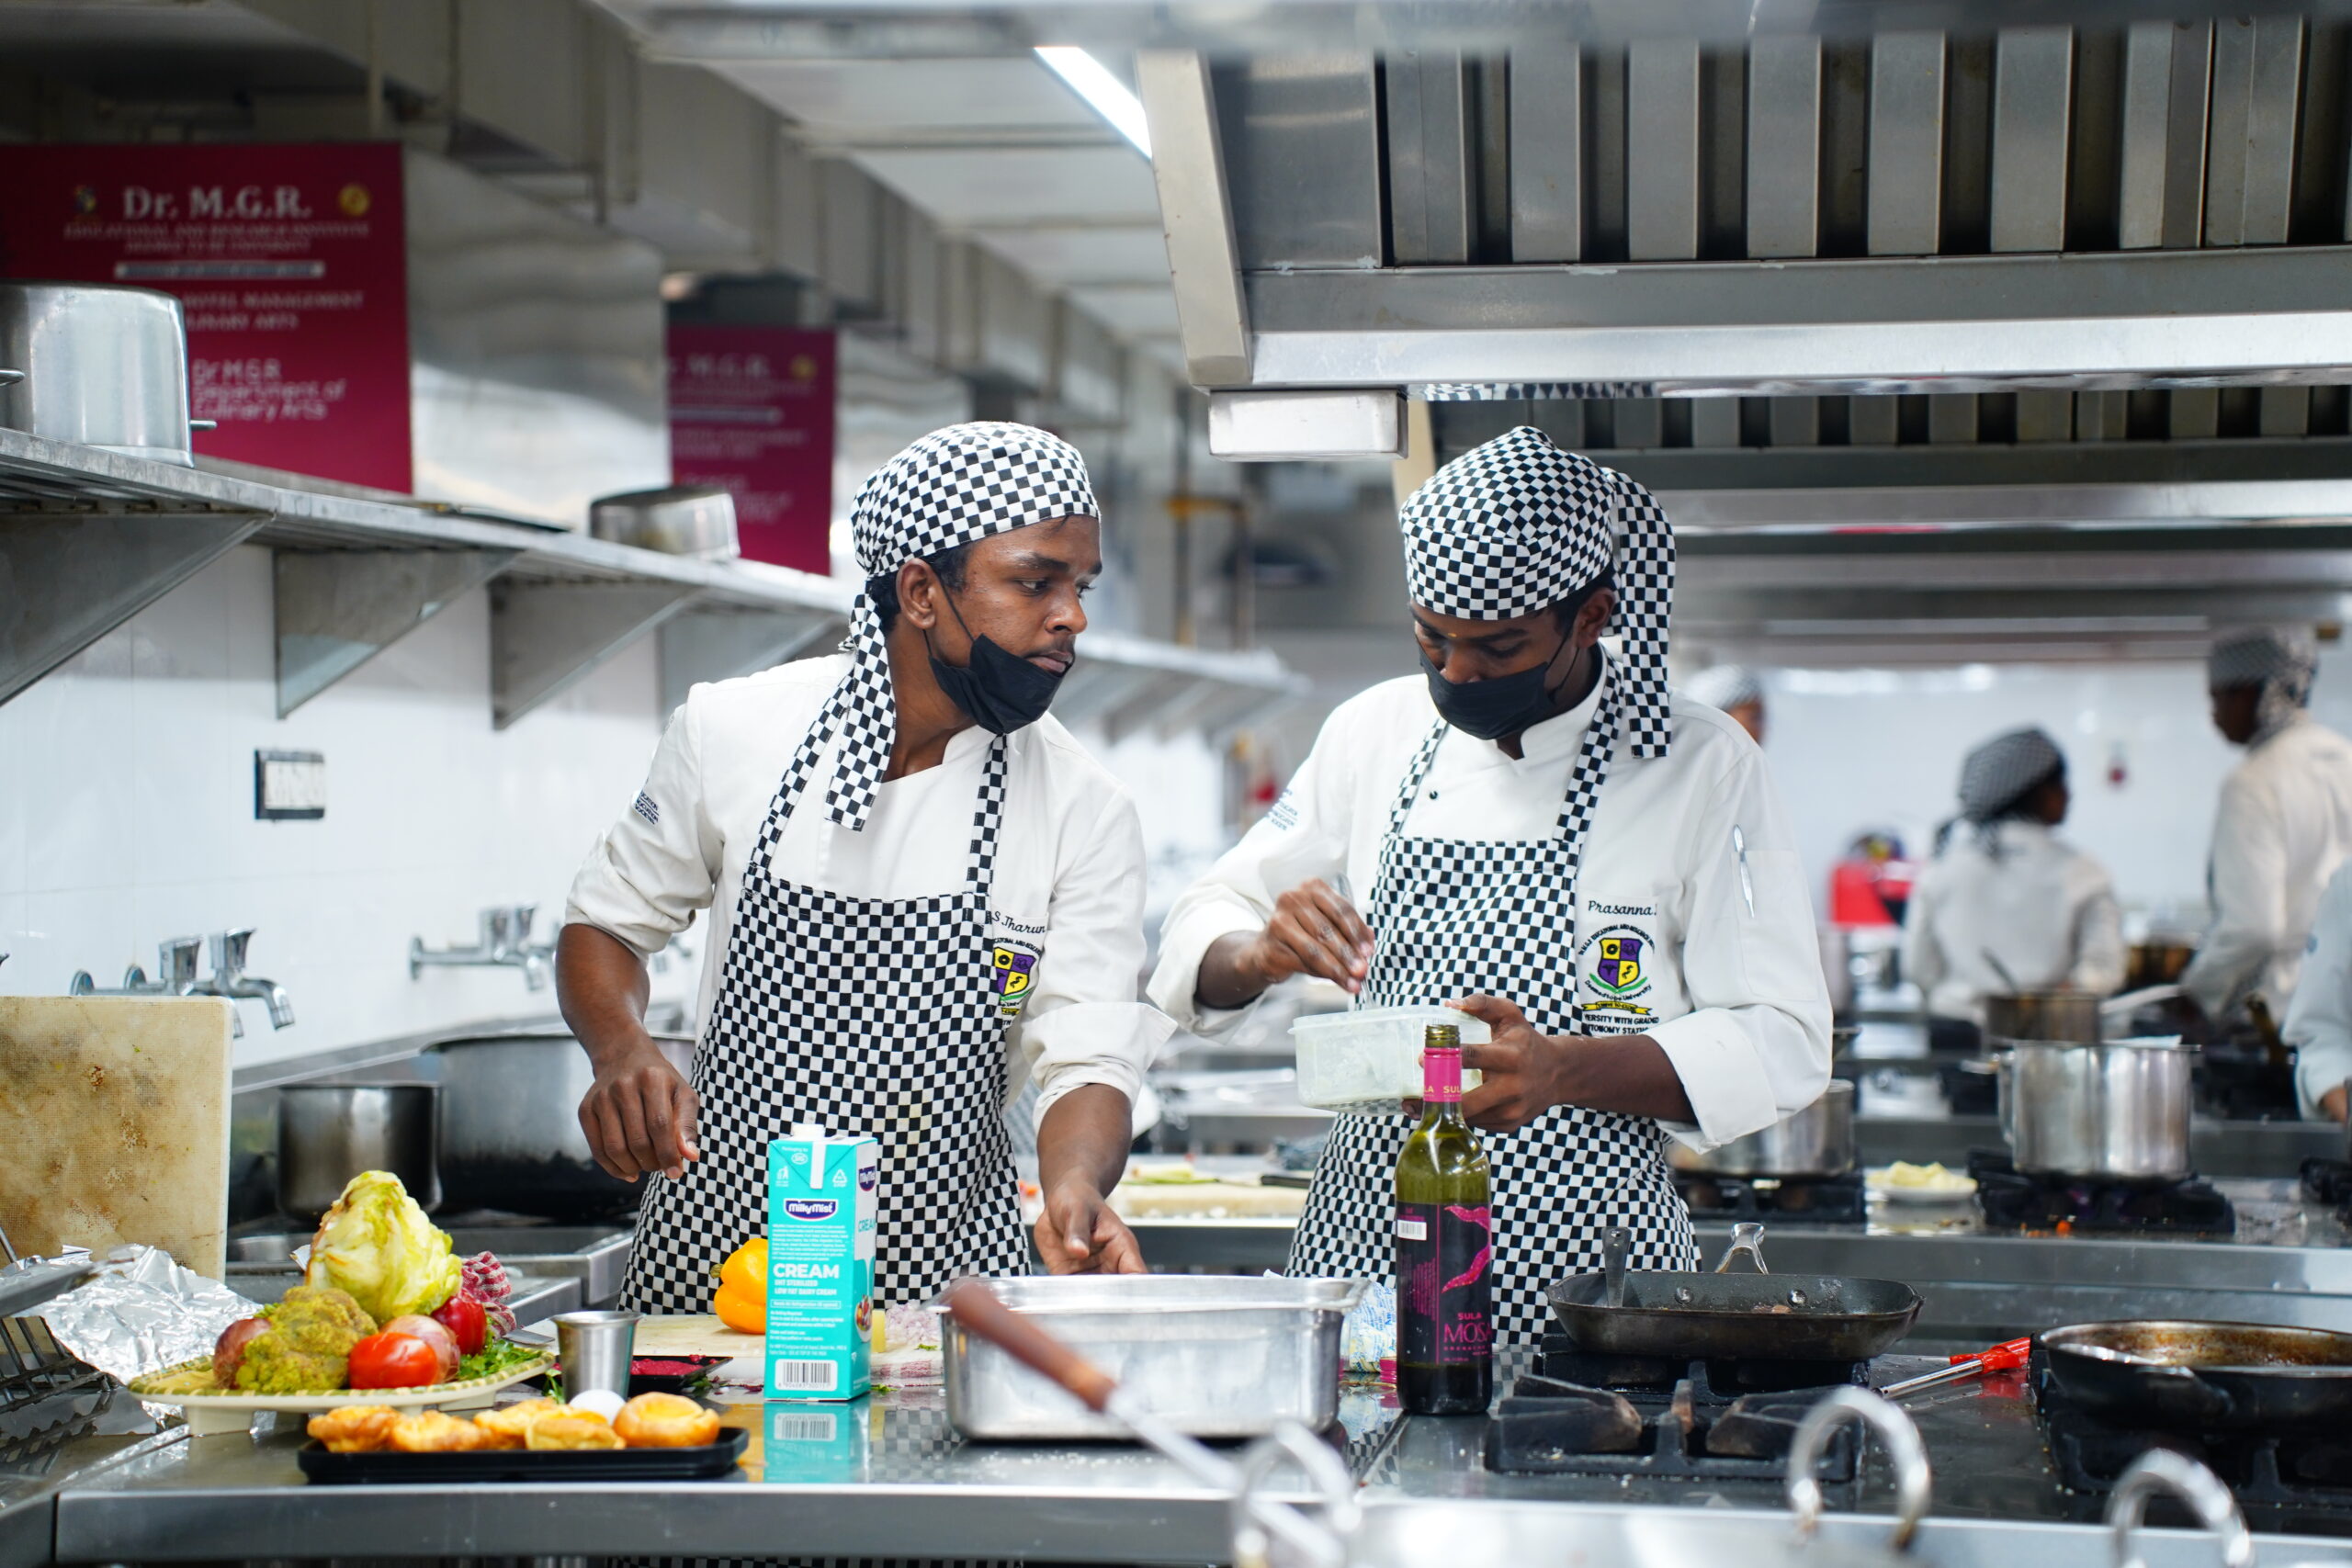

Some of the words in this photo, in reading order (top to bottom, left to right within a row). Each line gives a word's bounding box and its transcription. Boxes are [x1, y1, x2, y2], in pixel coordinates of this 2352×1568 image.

[122, 185, 178, 220] Dr.
[188, 185, 313, 220] M.G.R.
[243, 290, 365, 310] MANAGEMENT
[254, 313, 300, 332] ARTS
[1001, 916, 1046, 933] Tharun
[773, 1263, 840, 1279] CREAM
[1457, 1312, 1482, 1320] SULA
